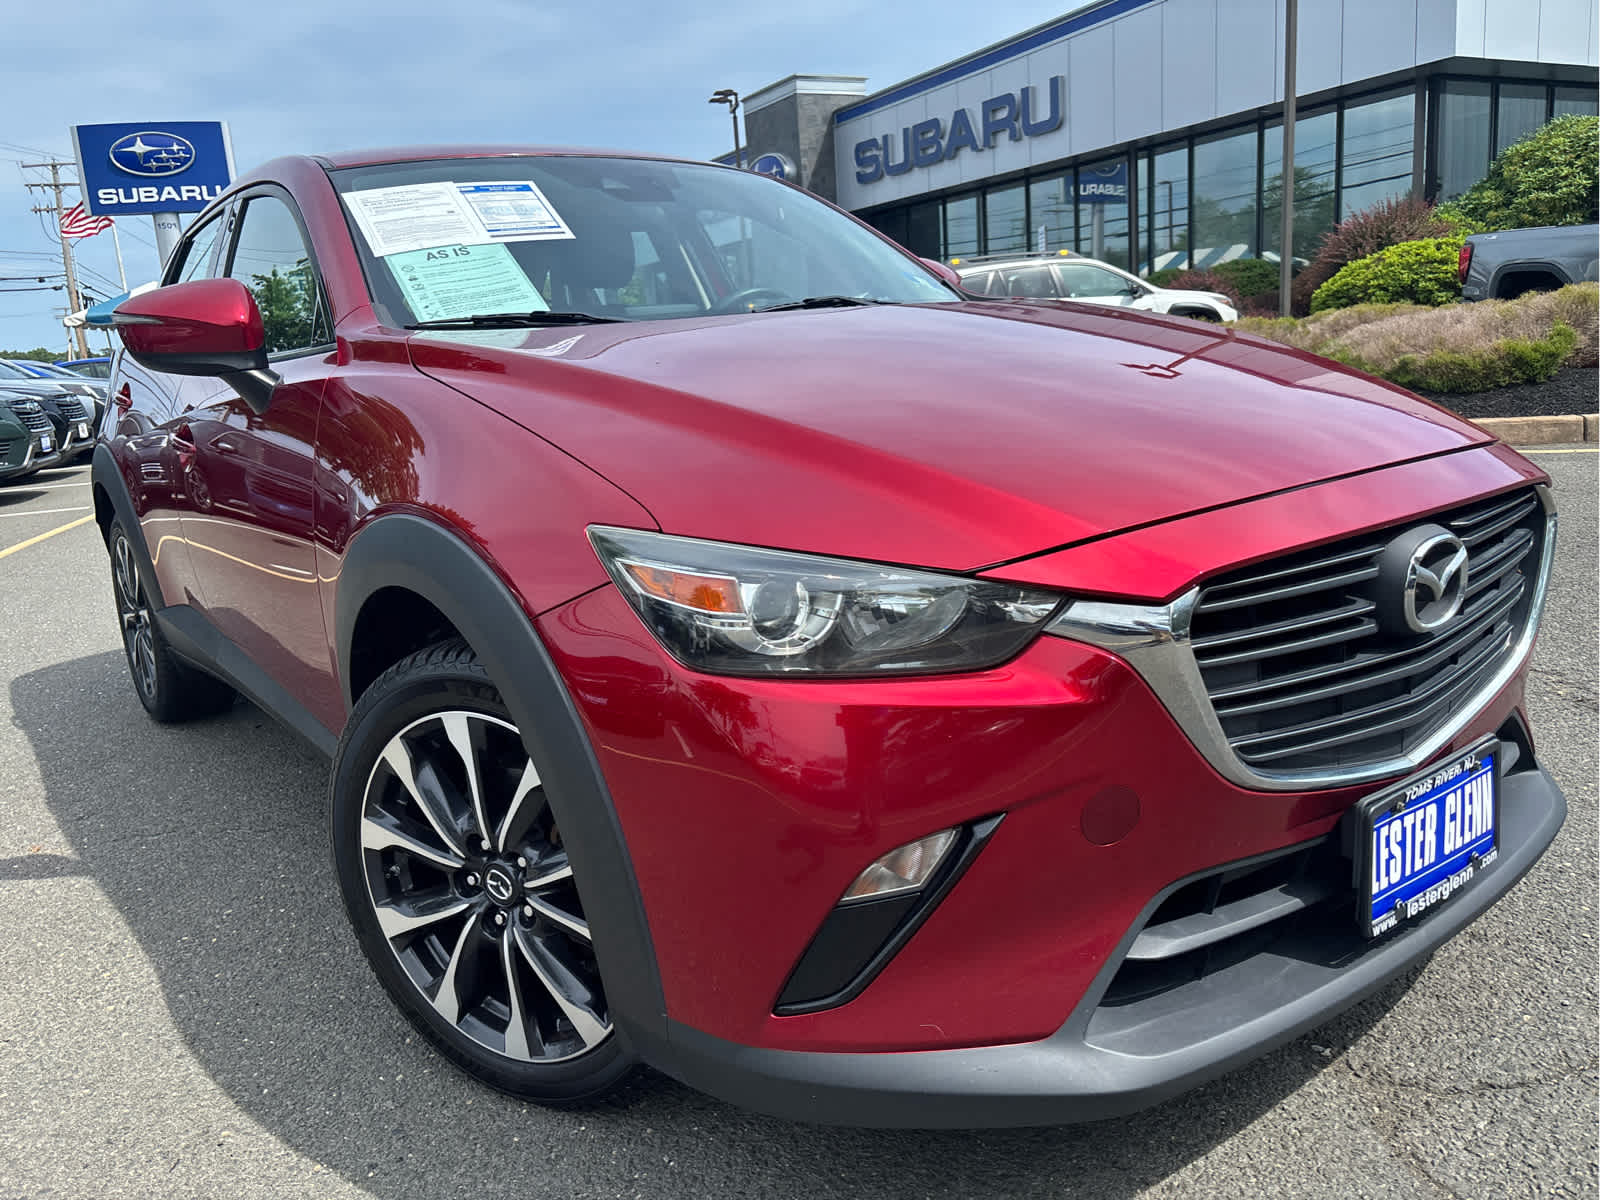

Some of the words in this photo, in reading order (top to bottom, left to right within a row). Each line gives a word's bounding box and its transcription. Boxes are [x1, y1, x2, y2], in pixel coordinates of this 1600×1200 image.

[854, 75, 1062, 185] SUBARU
[97, 185, 222, 205] SUBARU
[157, 222, 177, 230] 1501
[426, 249, 449, 262] AS
[452, 247, 471, 258] IS
[1405, 779, 1434, 802] TOMS
[1464, 755, 1476, 772] NJ
[1371, 802, 1438, 895] LESTER
[1443, 770, 1493, 856] GLENN
[1405, 865, 1474, 919] lesterglenn
